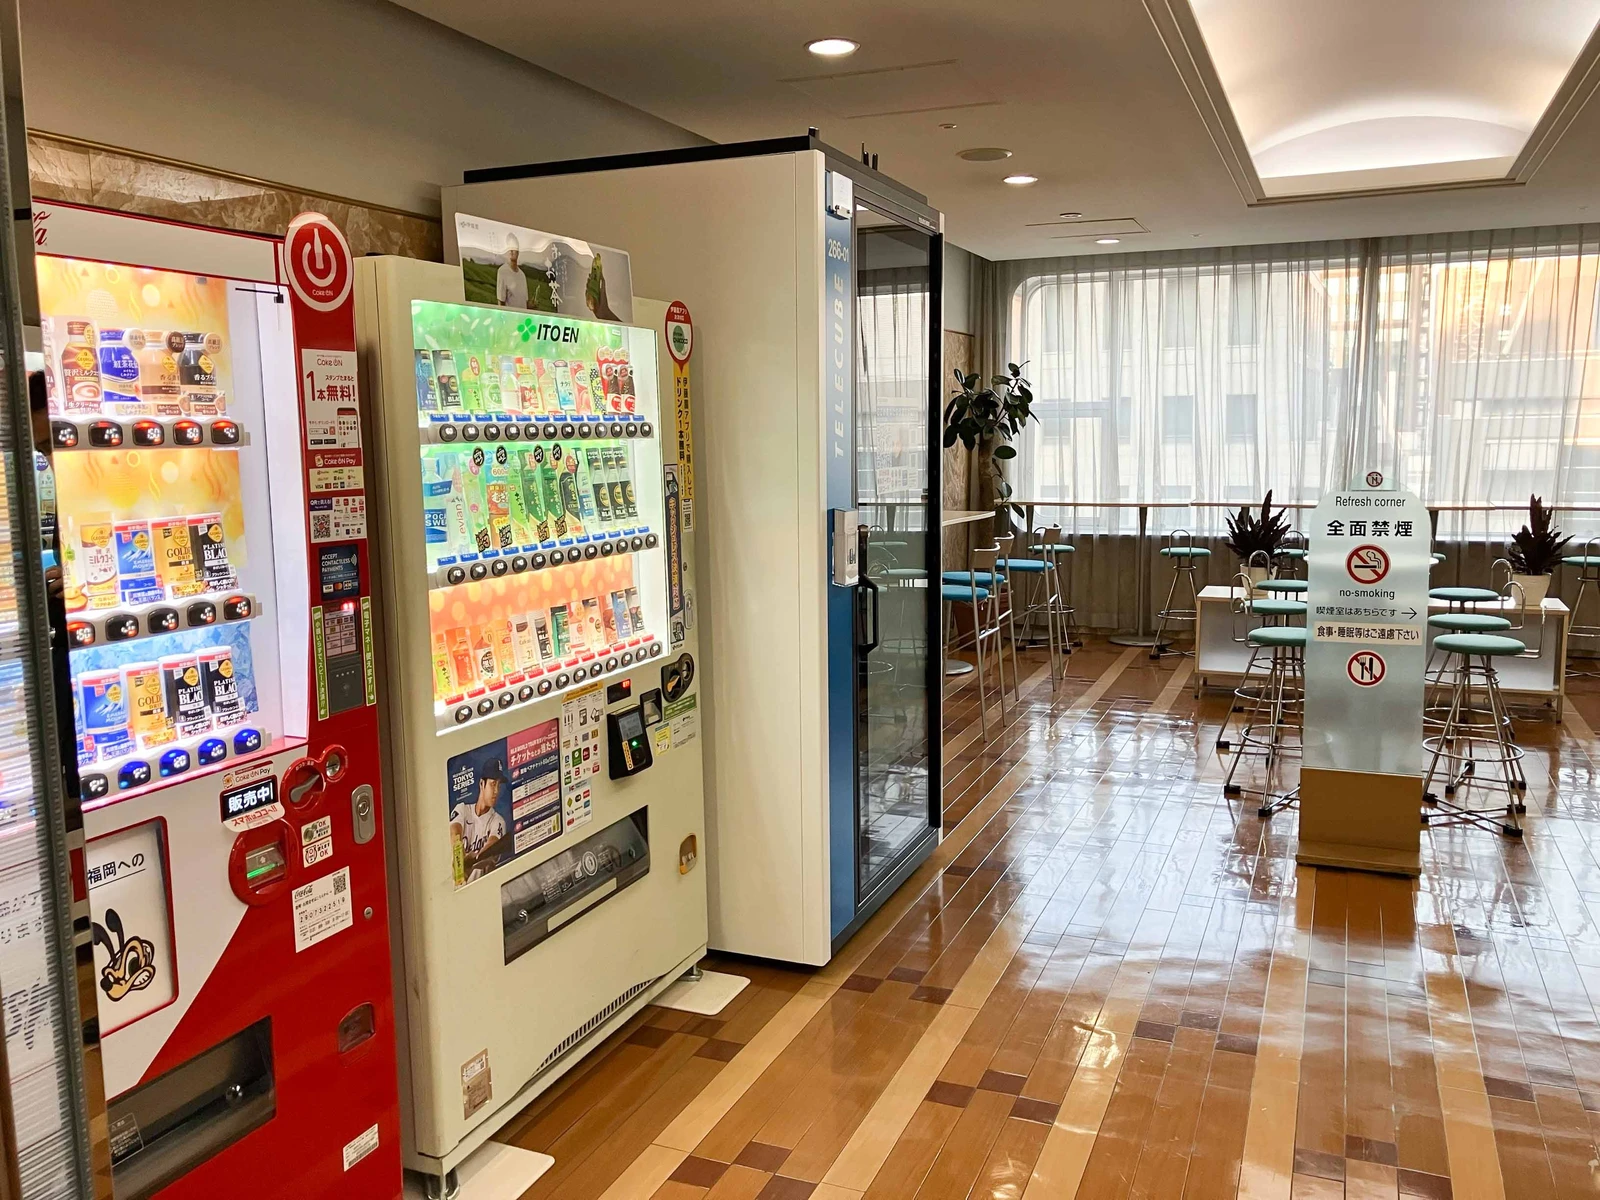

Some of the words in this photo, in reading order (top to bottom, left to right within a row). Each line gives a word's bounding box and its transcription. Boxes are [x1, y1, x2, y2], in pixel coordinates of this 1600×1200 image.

[828, 238, 849, 263] 266-01
[537, 323, 561, 342] ITO
[562, 327, 580, 343] EN
[316, 358, 333, 366] Coke
[333, 359, 343, 367] ON
[834, 272, 844, 458] TELECUBE
[346, 457, 357, 465] Pay
[1335, 496, 1372, 507] Refresh
[1374, 498, 1406, 507] corner
[455, 504, 465, 534] evian
[1326, 519, 1413, 537] 全面禁煙
[321, 557, 351, 567] CONTACTLESS
[321, 565, 344, 573] PAYMENTS
[1339, 588, 1395, 600] no-smoking
[1316, 606, 1398, 617] 喫煙室はあちらです
[1317, 625, 1419, 640] 食事・睡眠等はご遠慮下さい
[235, 774, 250, 783] Coke
[260, 767, 271, 775] Pay
[453, 771, 474, 784] TOKYO
[453, 777, 475, 792] SERIES
[228, 785, 270, 813] 販売中
[231, 804, 278, 827] スマホはココへ!!
[318, 820, 326, 828] OK
[319, 849, 329, 858] OK
